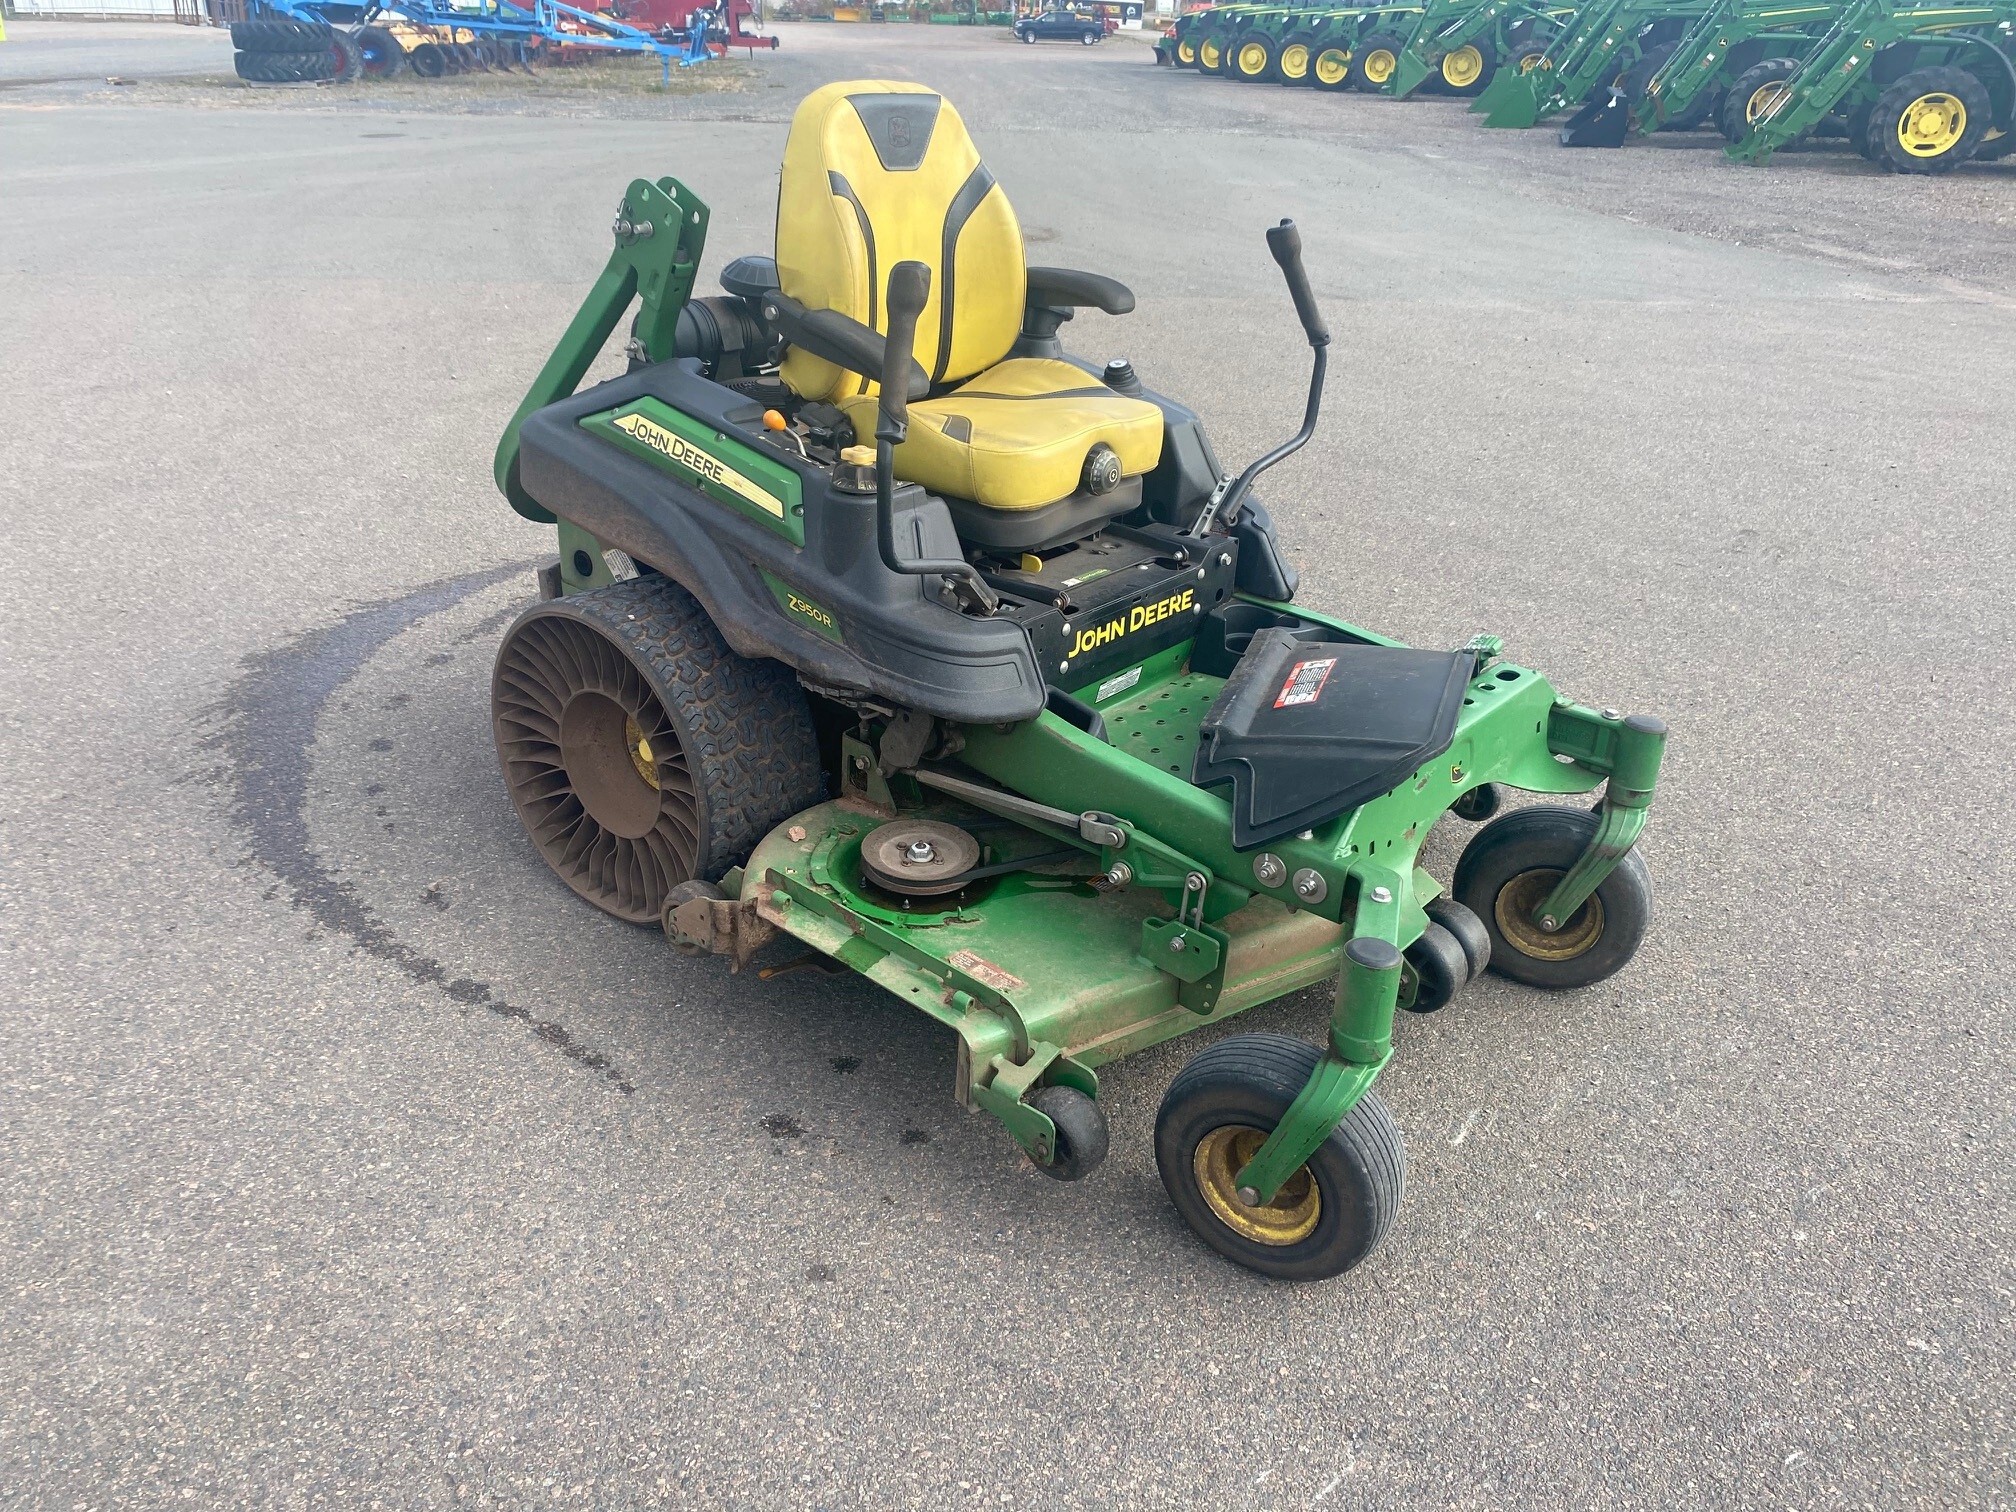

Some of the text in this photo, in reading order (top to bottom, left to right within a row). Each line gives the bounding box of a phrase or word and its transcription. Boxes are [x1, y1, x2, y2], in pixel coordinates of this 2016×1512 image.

[627, 417, 724, 483] JOHN DEERE
[786, 593, 832, 628] Z950R
[1068, 588, 1194, 659] JOHN DEERE
